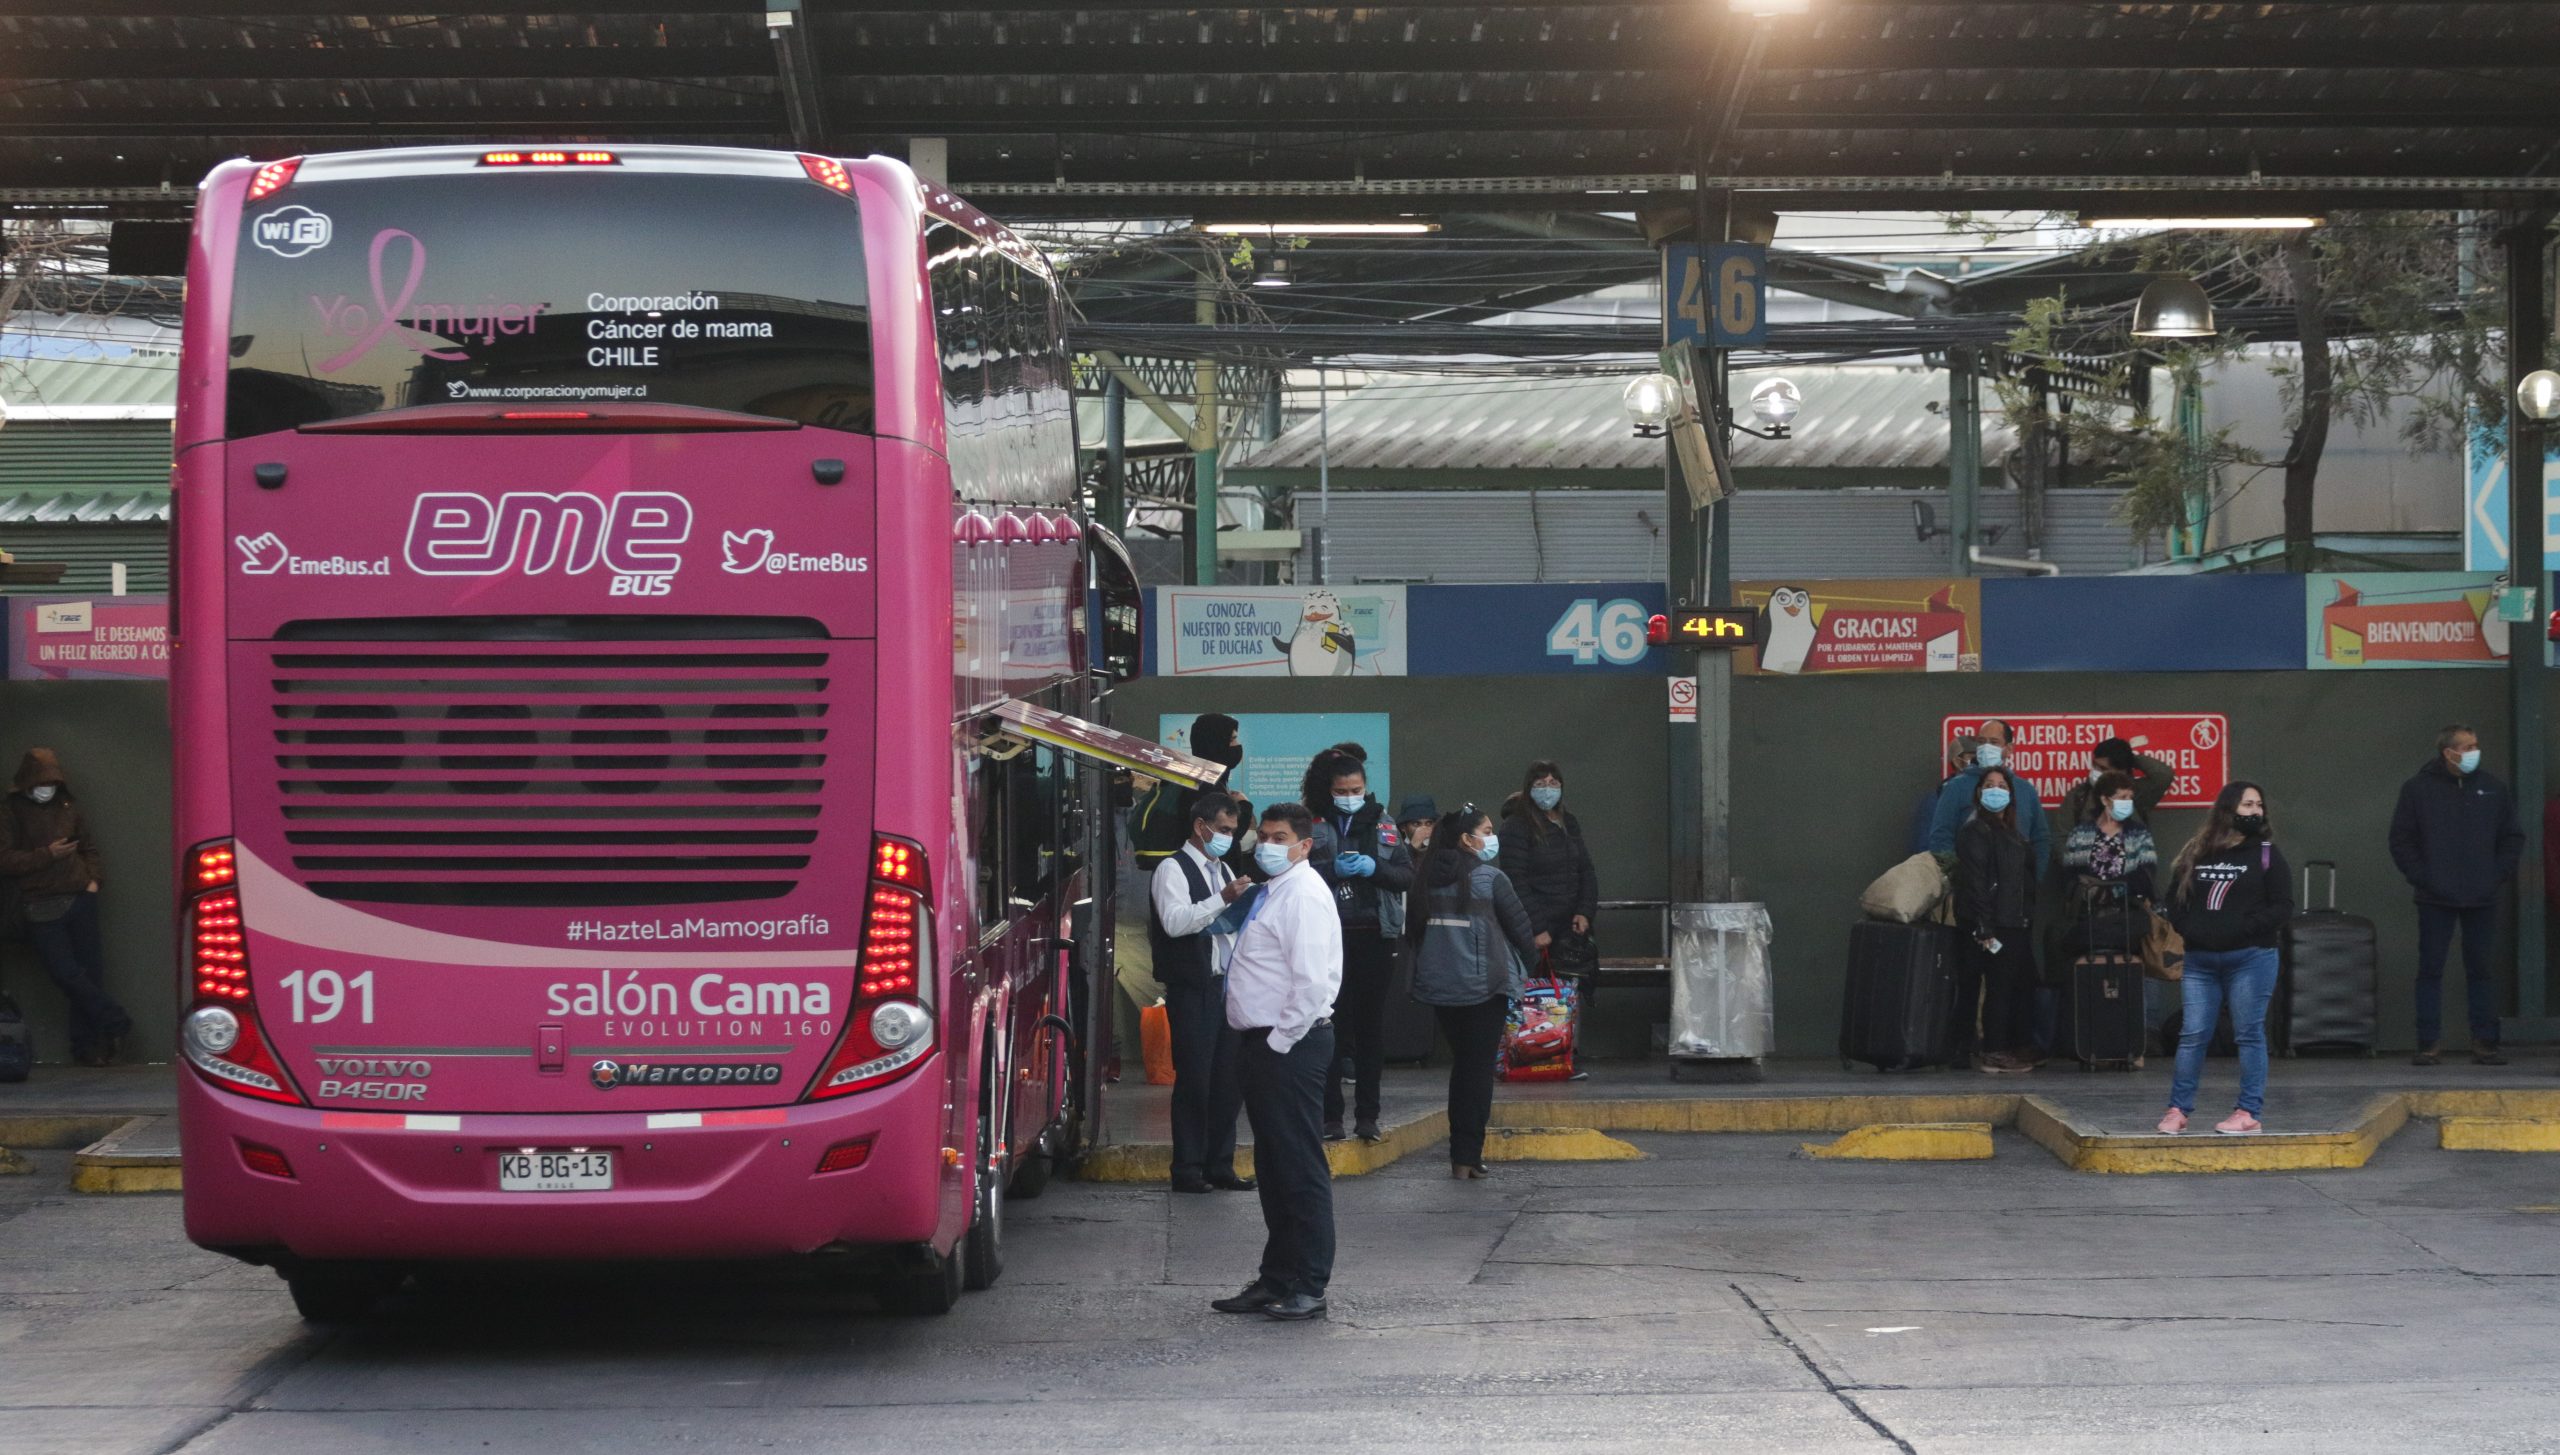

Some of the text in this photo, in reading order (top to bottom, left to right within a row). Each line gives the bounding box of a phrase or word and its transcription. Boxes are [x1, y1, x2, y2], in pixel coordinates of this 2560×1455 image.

[587, 291, 719, 315] Corporación
[1677, 255, 1756, 335] 46
[311, 295, 545, 345] Yo mujer
[587, 319, 773, 339] Cáncer de mama
[587, 347, 659, 367] CHILE
[468, 385, 647, 400] www.corporacionyomujer.cl
[404, 491, 693, 575] eme
[288, 556, 391, 575] EmeBus.cl
[765, 553, 868, 574] @EmeBus
[608, 575, 674, 596] BUS
[1206, 602, 1256, 618] CONOZCA
[95, 626, 167, 642] LE DESEAMOS
[1182, 621, 1282, 637] NUESTRO SERVICIO
[1548, 599, 1648, 663] 46
[1833, 617, 1918, 638] GRACIAS!
[2367, 621, 2475, 644] BIENVENIDOS!!!
[40, 645, 55, 660] UN
[59, 645, 87, 660] FELIZ
[90, 644, 138, 660] REGRESO
[141, 645, 149, 659] A
[1202, 639, 1263, 655] DE DUCHAS
[1817, 642, 1923, 652] POR AYUDARNOS A MANTENER
[1837, 654, 1861, 662] ORDEN
[1870, 654, 1880, 662] LA
[1881, 653, 1914, 662] LIMPIEZA
[2010, 724, 2072, 746] SAJERO:
[2075, 724, 2117, 745] ESTA
[2180, 749, 2200, 769] EL
[566, 914, 829, 941] #HazteLaMamografía
[279, 969, 374, 1024] 191
[546, 970, 831, 1016] salón Cama
[605, 1020, 831, 1037] EVOLUTION 160
[315, 1058, 432, 1079] VOLVO
[625, 1063, 780, 1083] Marcopolo
[318, 1080, 428, 1101] B450R
